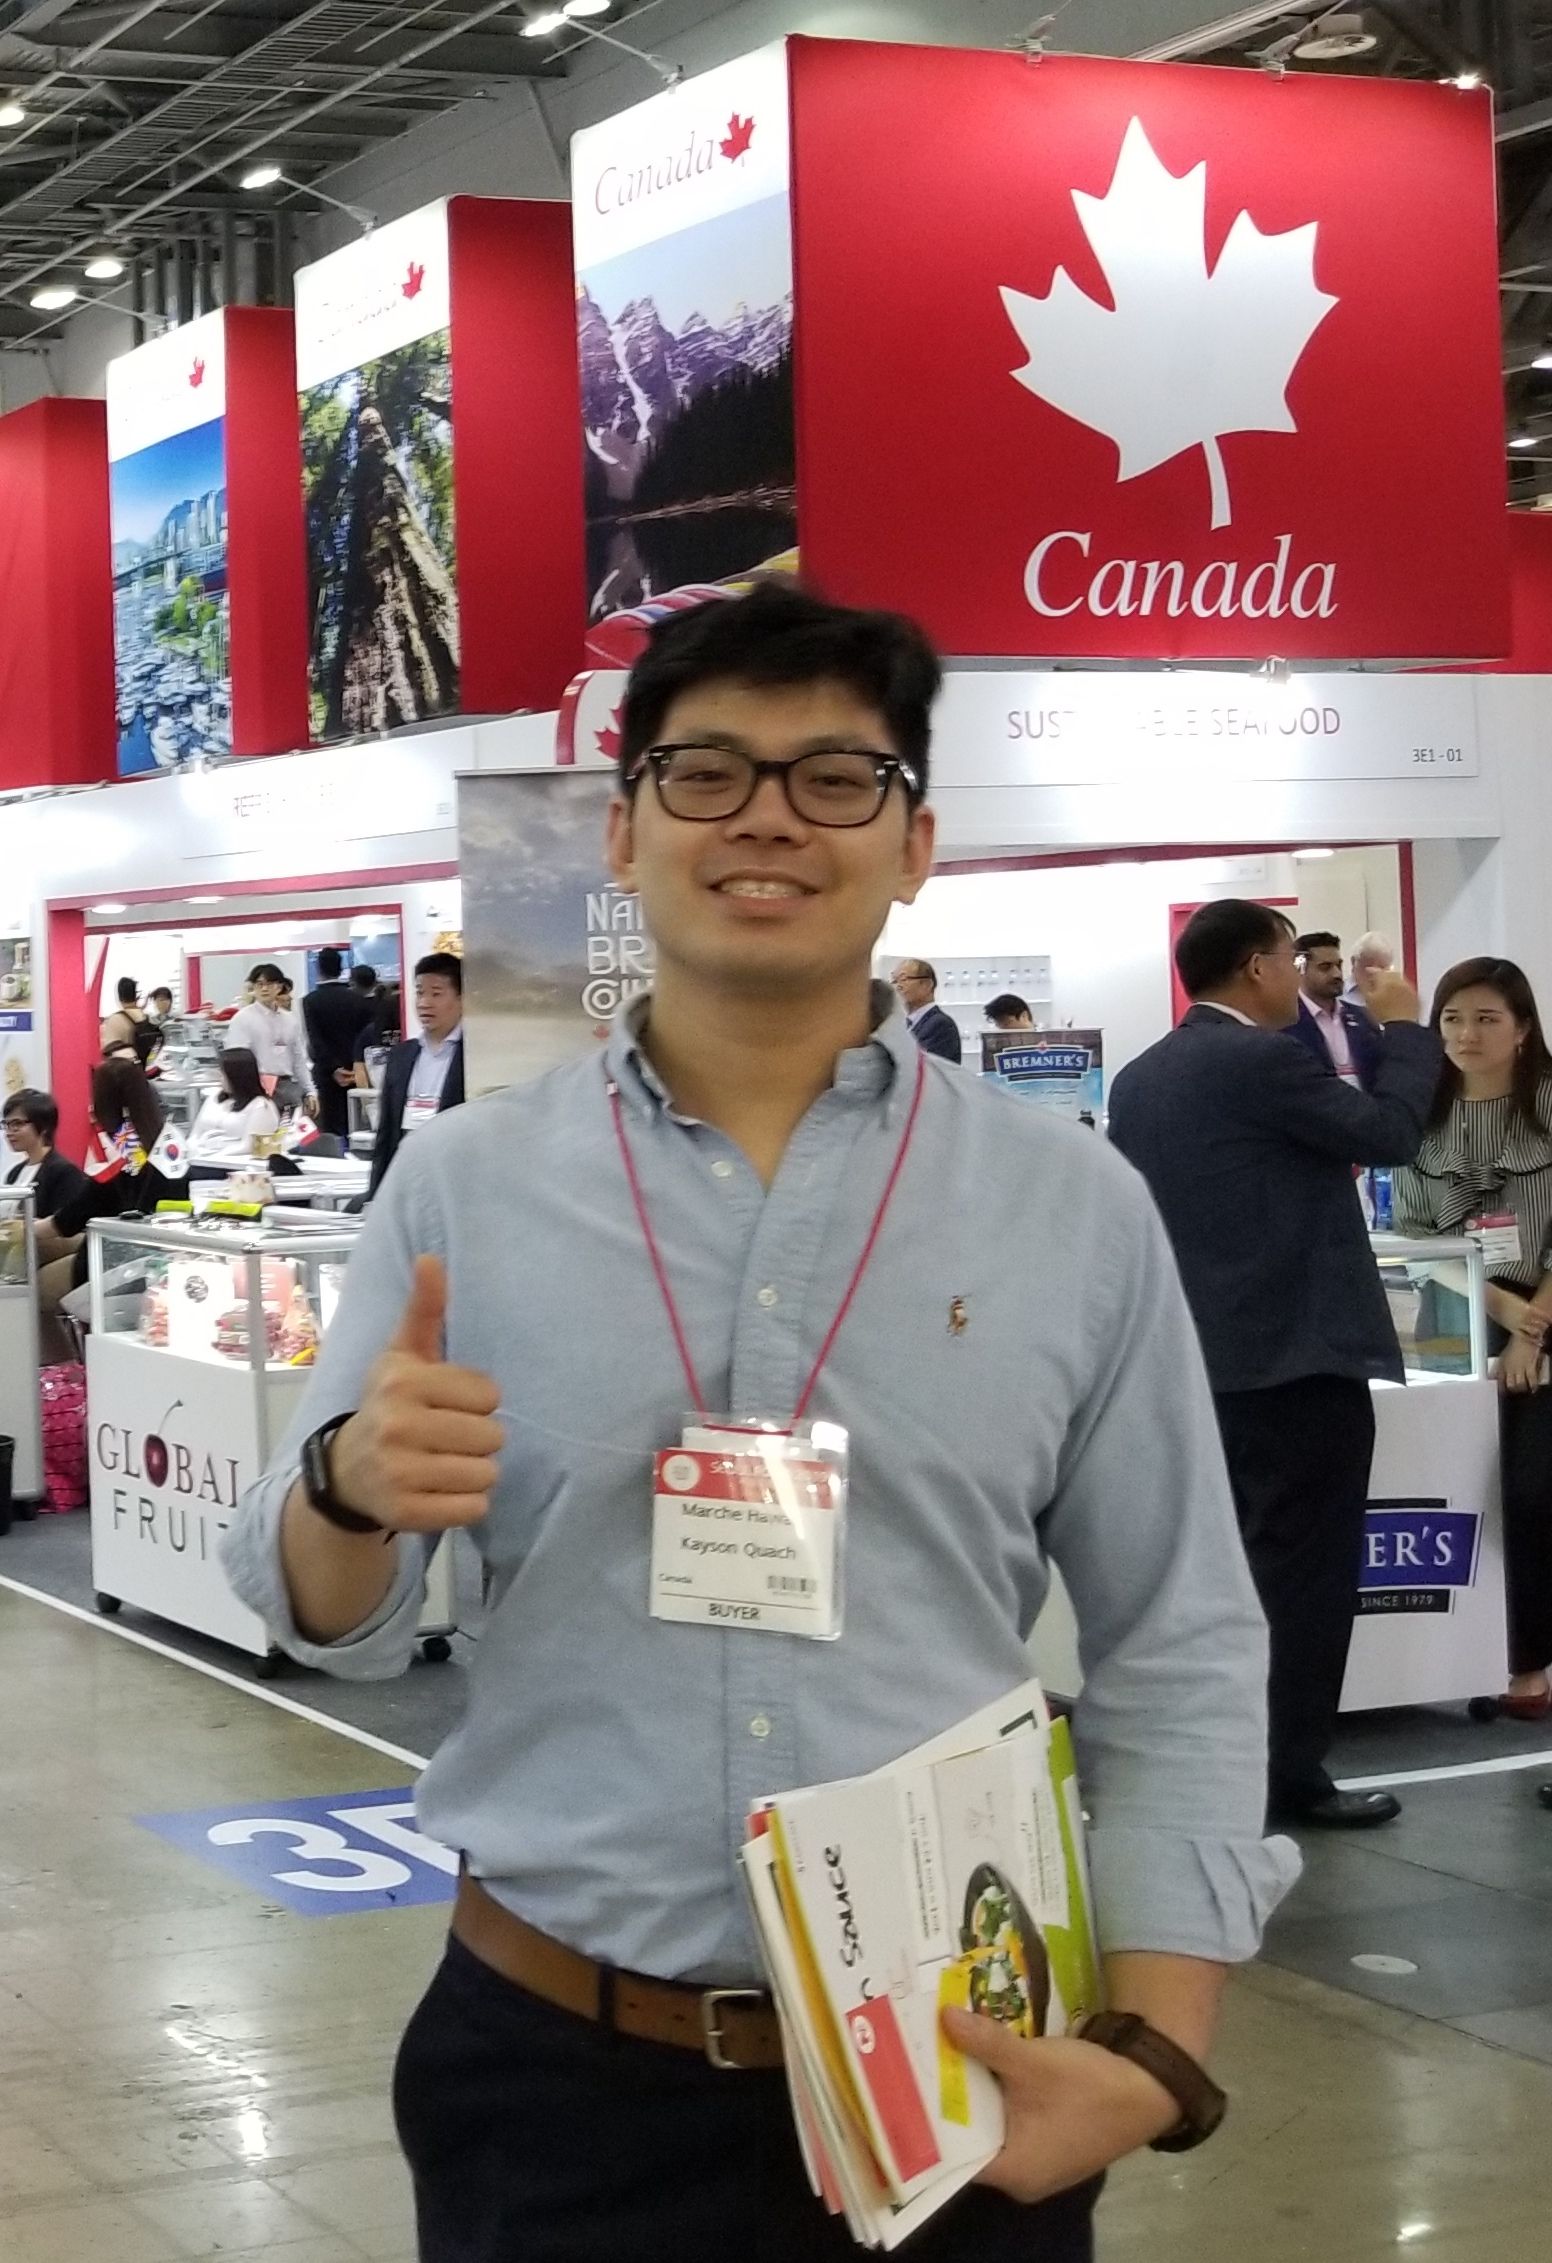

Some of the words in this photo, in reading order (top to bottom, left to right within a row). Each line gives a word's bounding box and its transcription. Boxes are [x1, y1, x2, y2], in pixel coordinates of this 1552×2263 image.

[594, 130, 715, 215] Canada
[1023, 530, 1339, 619] Canada
[1411, 748, 1465, 763] 3E1-01
[1003, 1053, 1085, 1071] BREMNER'S
[681, 1503, 743, 1521] Marche
[680, 1536, 738, 1556] Kayson
[743, 1541, 797, 1559] Quach
[708, 1602, 761, 1620] BUYER
[1361, 1595, 1399, 1609] SINCE
